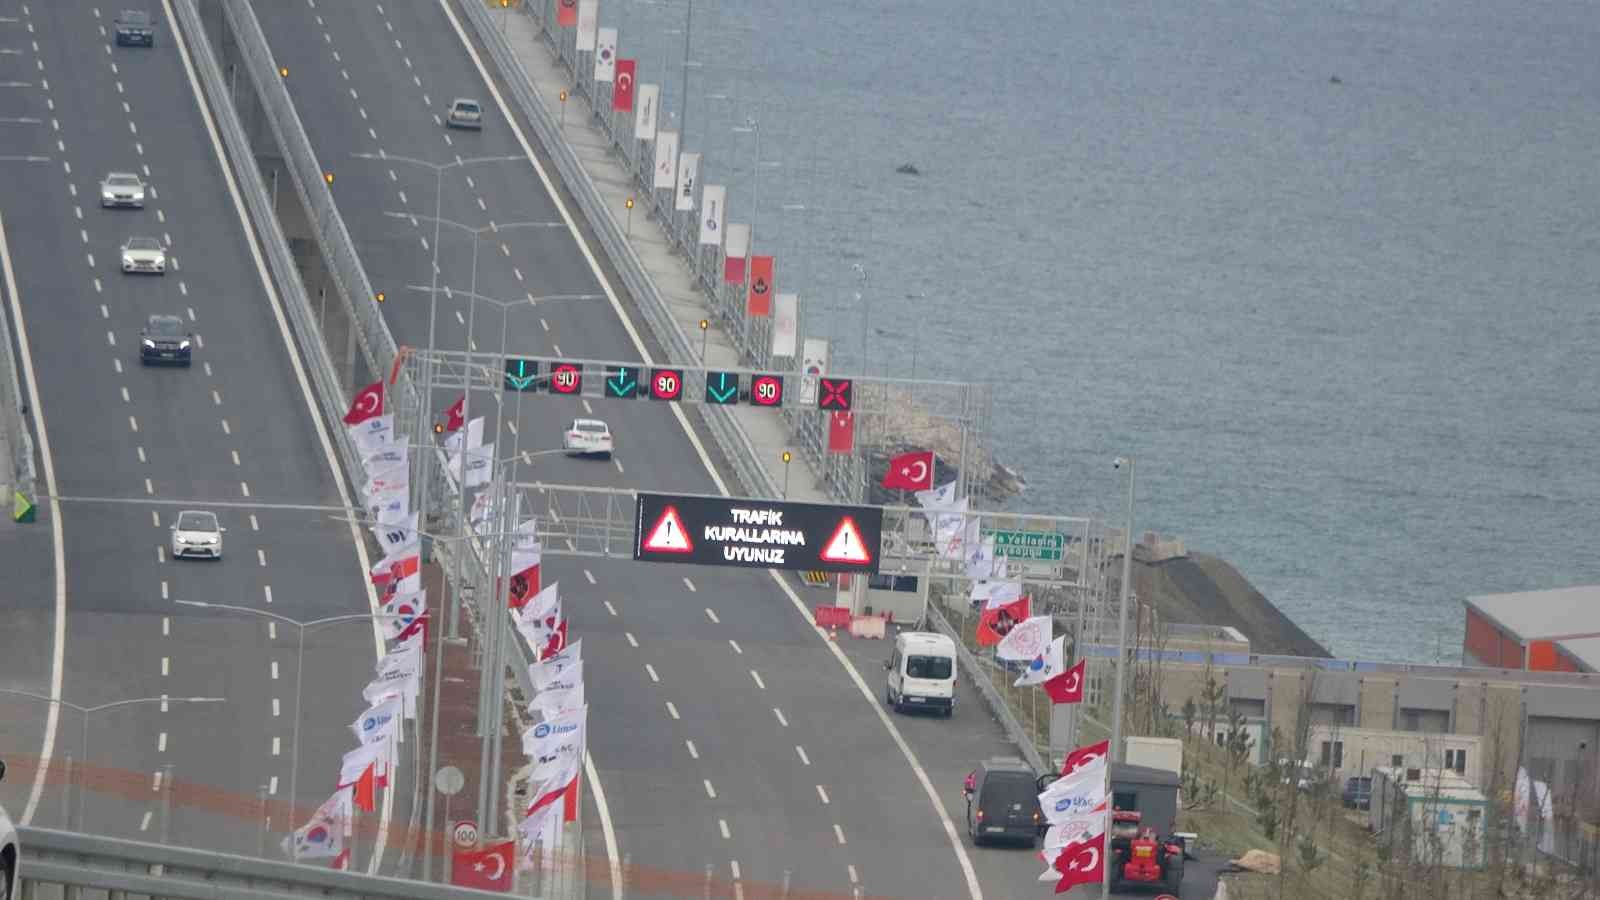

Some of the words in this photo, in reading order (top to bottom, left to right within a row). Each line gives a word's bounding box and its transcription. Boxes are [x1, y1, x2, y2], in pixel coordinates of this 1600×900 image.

[557, 371, 574, 387] 90
[657, 379, 675, 392] 90
[758, 384, 776, 398] 90
[731, 508, 783, 526] TRAFİK
[704, 526, 806, 546] KURALLARINA
[723, 546, 785, 564] UYUNUZ
[457, 830, 475, 841] 100
